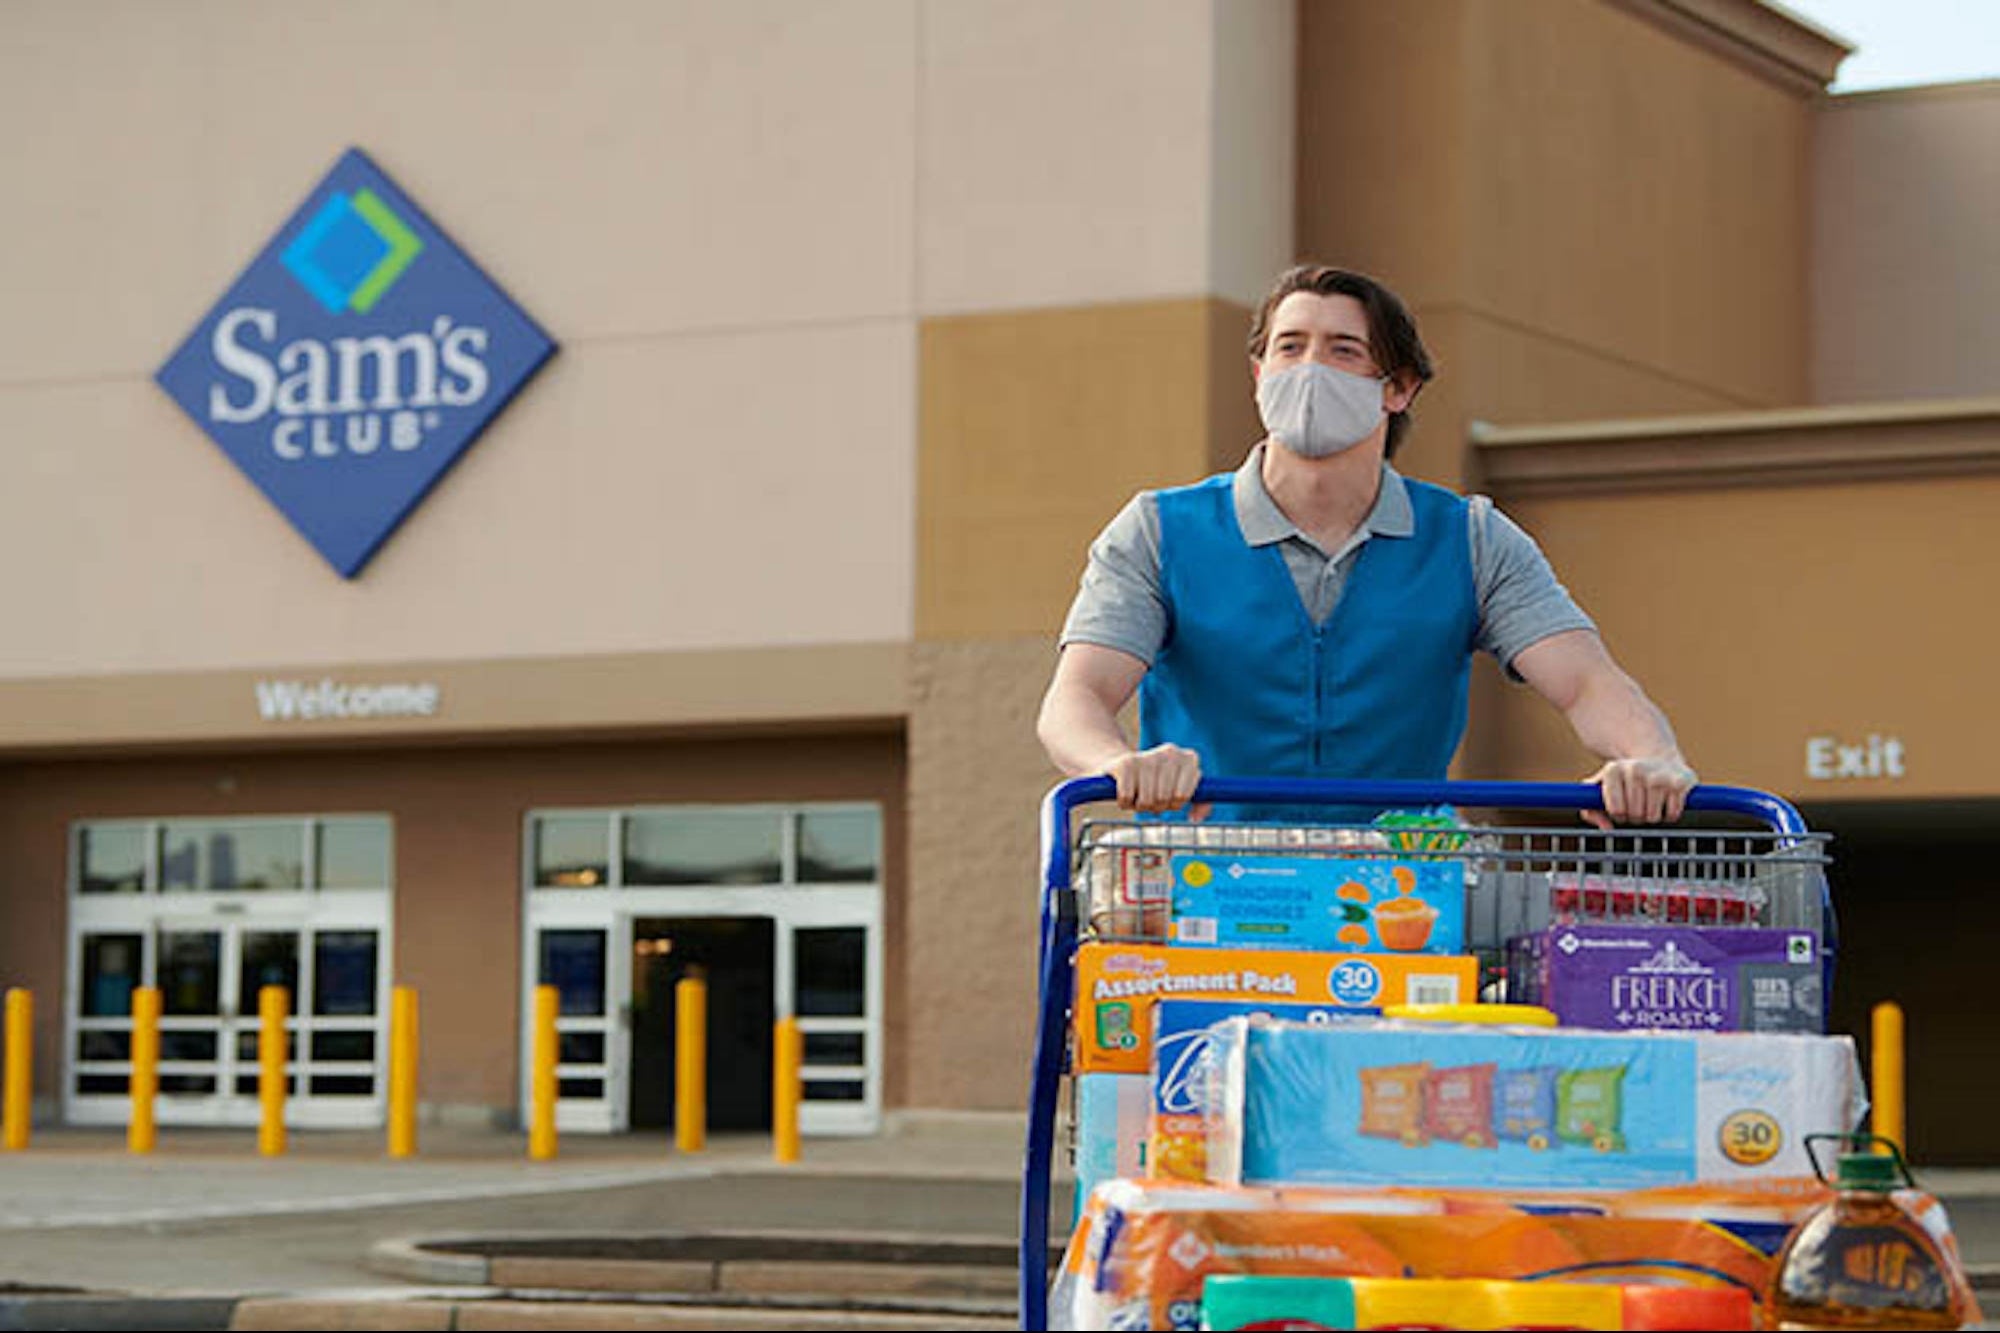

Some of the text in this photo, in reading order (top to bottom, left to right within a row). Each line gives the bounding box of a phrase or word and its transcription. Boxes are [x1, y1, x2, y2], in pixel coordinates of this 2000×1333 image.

[210, 307, 489, 423] Sam's
[273, 411, 422, 460] CLUB
[256, 678, 439, 721] Welcome
[1807, 733, 1906, 778] Exit
[1095, 971, 1297, 999] Assortment Pack
[1335, 966, 1374, 990] 30
[1611, 975, 1729, 1010] FRENCH
[1635, 1010, 1705, 1027] ROAST
[1732, 1122, 1772, 1146] 30
